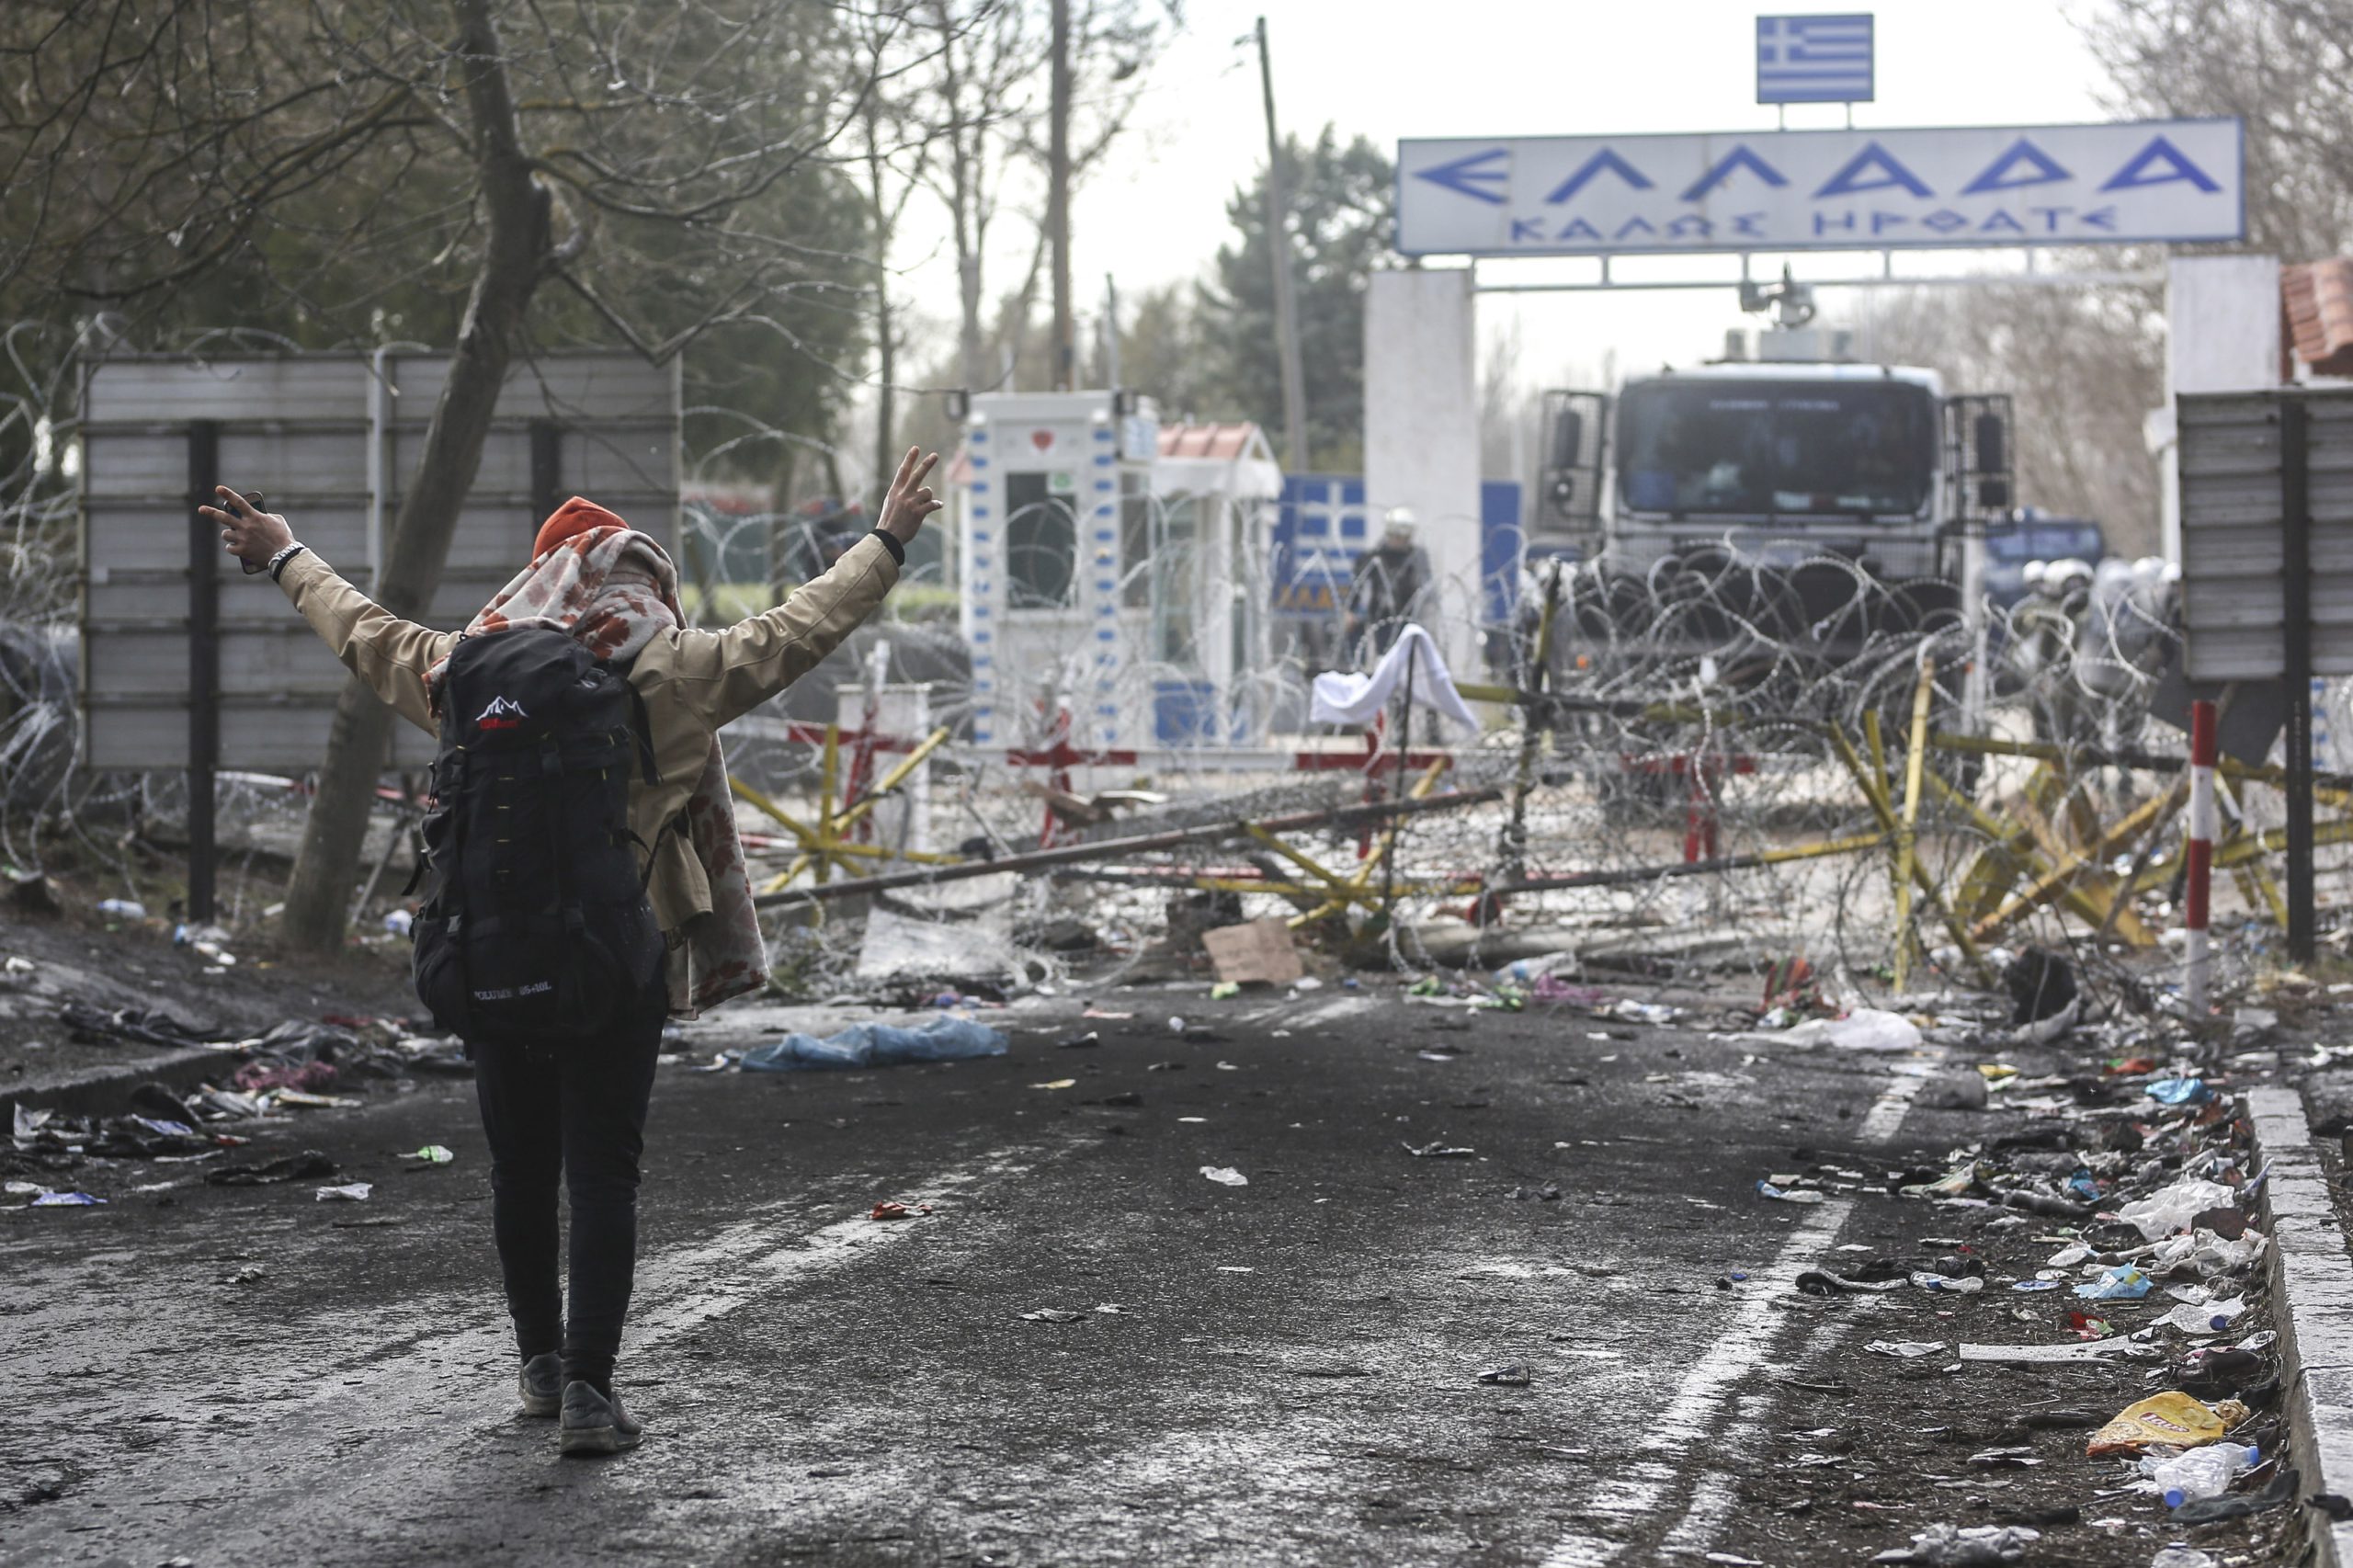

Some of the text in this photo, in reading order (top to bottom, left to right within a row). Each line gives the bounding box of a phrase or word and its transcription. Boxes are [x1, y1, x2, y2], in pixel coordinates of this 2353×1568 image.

[1412, 133, 2224, 205] ΕΛΛΑΔΑ
[1510, 205, 2119, 242] ΚΑΛΩΣ ΗΡΘΑΤΕ
